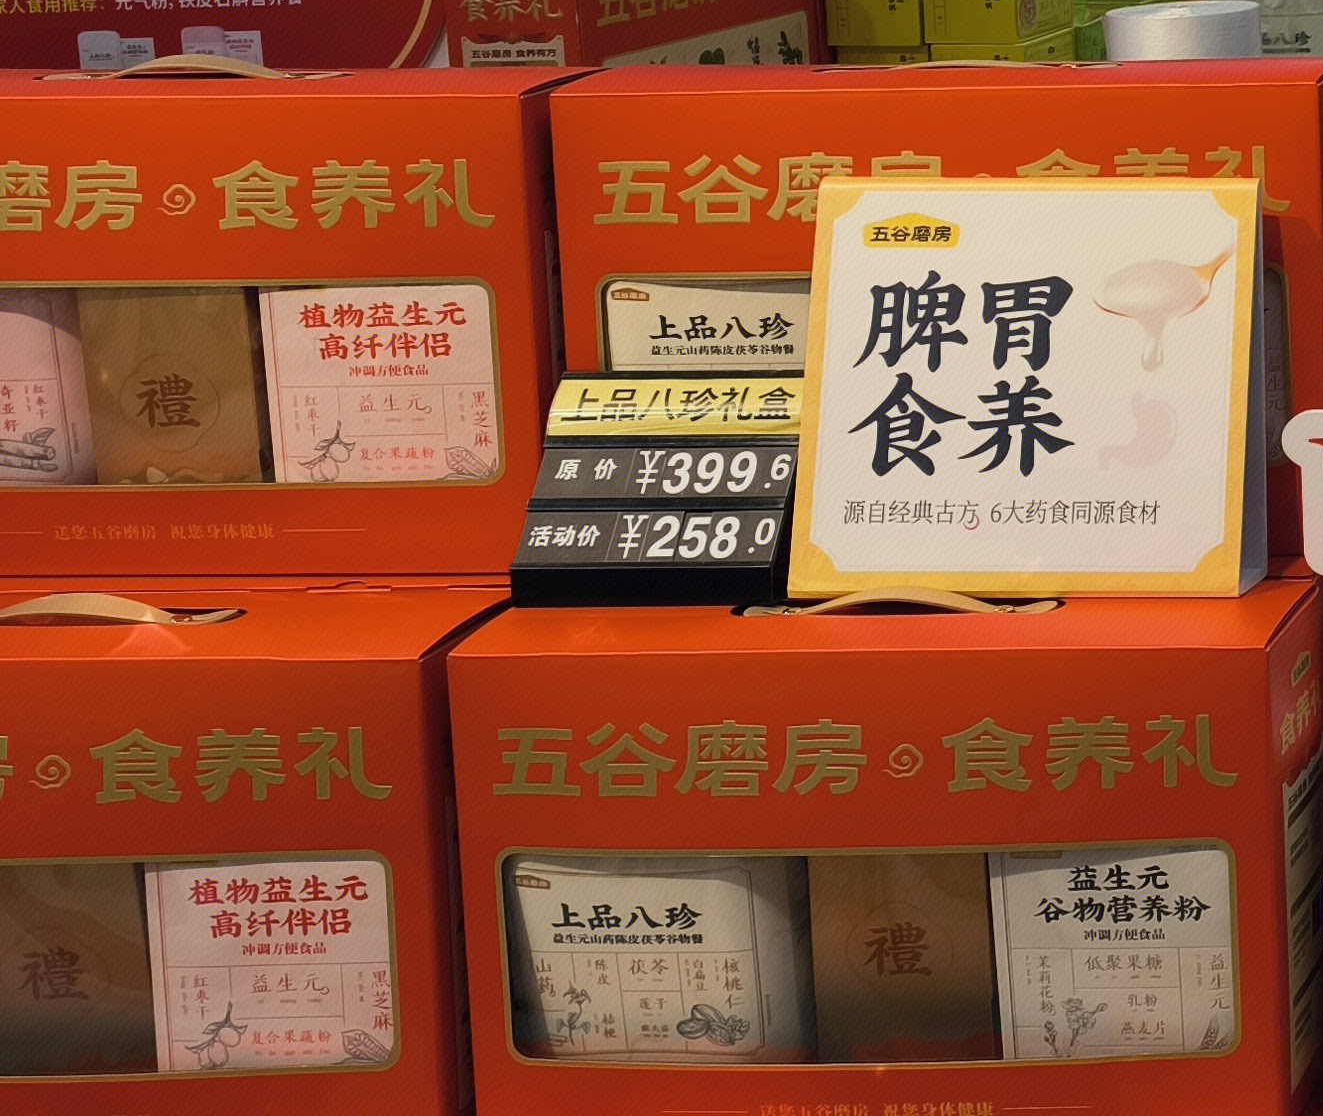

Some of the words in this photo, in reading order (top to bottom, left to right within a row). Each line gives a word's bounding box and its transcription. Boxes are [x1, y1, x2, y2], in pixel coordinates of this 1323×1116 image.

[212, 159, 496, 230] 食养礼
[870, 224, 952, 243] 五谷磨房
[297, 301, 467, 328] 植物益生元
[649, 313, 793, 341] 上品八珍
[853, 269, 1075, 372] 脾胃
[319, 332, 452, 359] 高纤伴侣
[135, 373, 200, 429] 禮
[560, 387, 796, 422] 上品八珍礼盒
[471, 391, 493, 448] 黑芝麻
[848, 373, 1075, 477] 食养
[554, 458, 618, 482] 原价
[636, 448, 791, 495] ¥399.6
[843, 500, 979, 527] 源自经典古方
[989, 499, 1160, 525] 6大药食同源食材
[528, 523, 601, 548] 活动价
[618, 513, 776, 563] ¥258.0
[89, 726, 393, 804] 食养礼
[492, 717, 867, 796] 五谷磨房
[941, 714, 1238, 793] 食养礼
[187, 874, 368, 905] 植物益生元
[1067, 865, 1169, 892] 益生元
[210, 907, 353, 939] 高纤伴侣
[552, 903, 702, 930] 上品八珍
[1034, 895, 1211, 923] 谷物营养粉
[862, 922, 933, 979] 禮
[1085, 954, 1162, 971] 低聚果糖
[594, 958, 612, 985] 陈皮
[628, 958, 670, 976] 茯苓
[1209, 953, 1230, 1010] 益生元
[722, 957, 745, 1010] 核桃仁
[370, 970, 393, 1031] 黑芝麻
[1128, 993, 1158, 1007] 乳粉
[1121, 1021, 1165, 1035] 燕麦片
